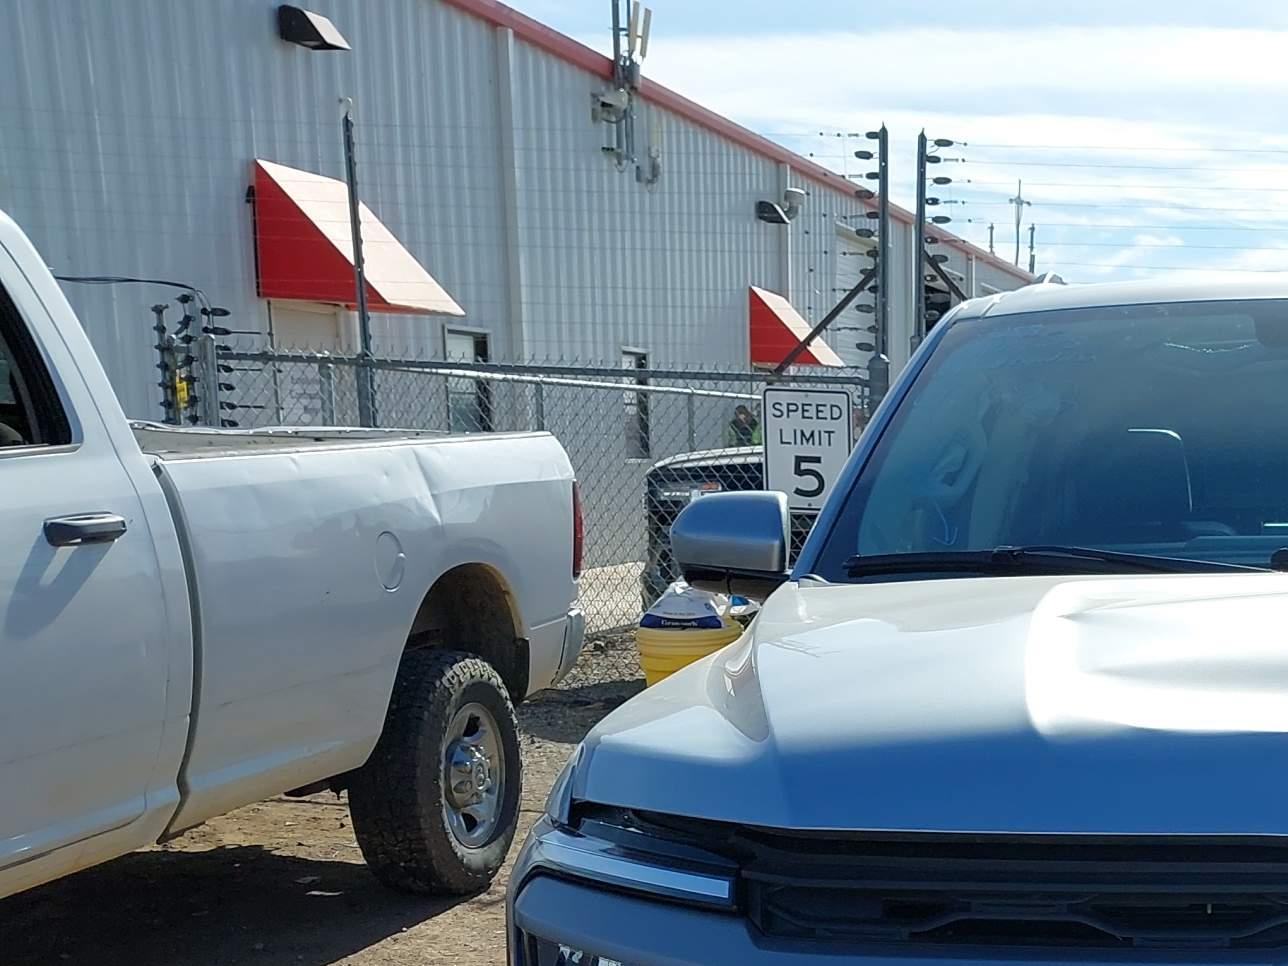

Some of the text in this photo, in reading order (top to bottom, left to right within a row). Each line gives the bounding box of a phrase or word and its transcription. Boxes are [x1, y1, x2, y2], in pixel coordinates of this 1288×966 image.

[772, 402, 843, 421] SPEED
[779, 428, 836, 447] LIMIT
[793, 455, 826, 498] 5
